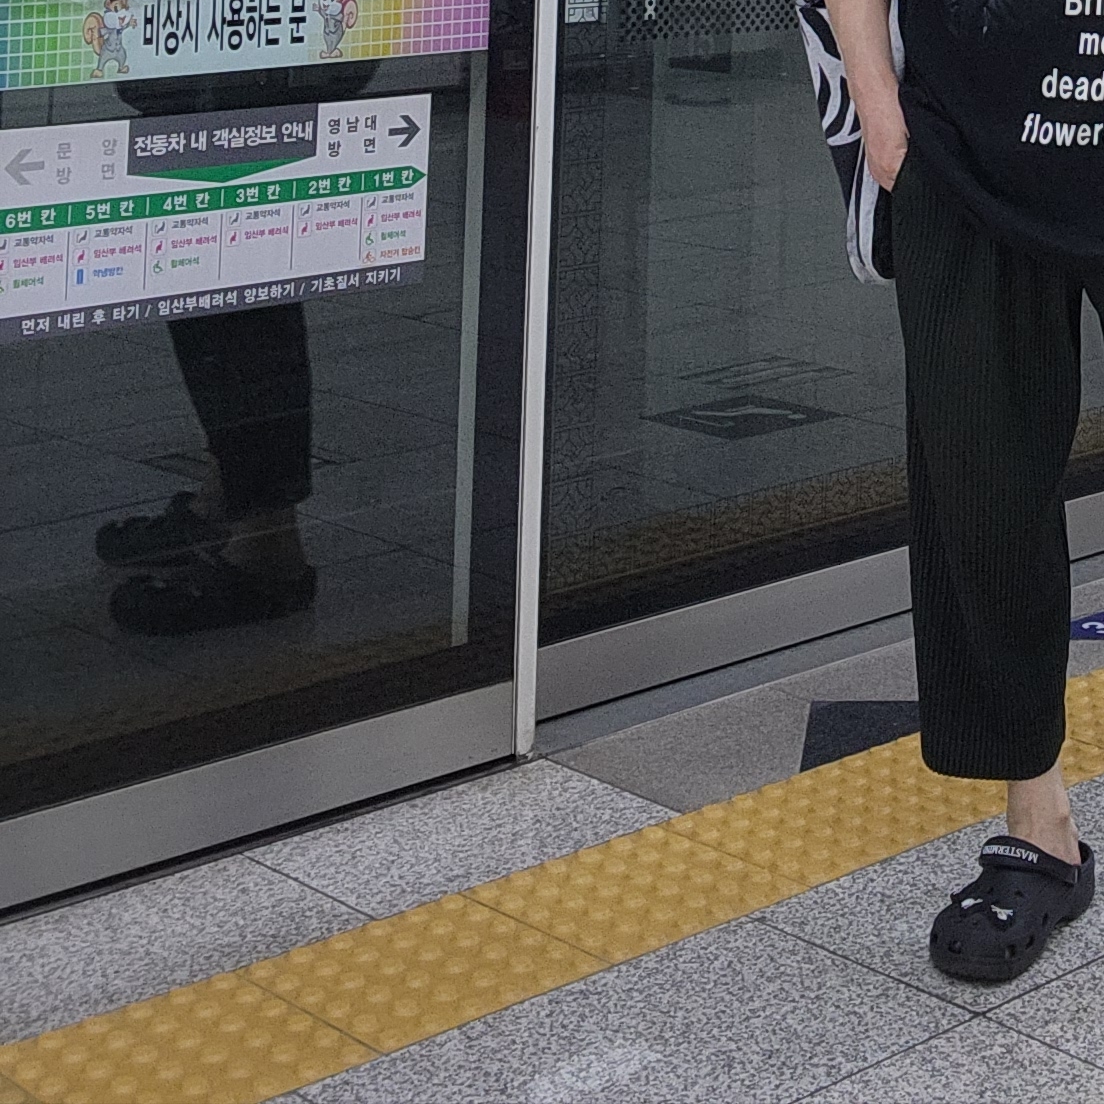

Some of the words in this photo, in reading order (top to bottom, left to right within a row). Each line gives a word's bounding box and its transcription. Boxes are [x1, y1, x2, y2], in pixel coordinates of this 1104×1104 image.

[328, 114, 377, 135] 영남대
[133, 131, 186, 157] 전동차
[190, 130, 207, 152] 내
[212, 123, 277, 149] 객실정보
[281, 120, 314, 143] 안내
[308, 178, 331, 195] 2번
[338, 176, 351, 193] 칸
[373, 173, 395, 188] 1번
[401, 169, 415, 185] 칸
[162, 194, 187, 211] 4번
[195, 192, 210, 209] 칸
[235, 187, 260, 203] 3번
[267, 184, 281, 200] 칸
[5, 211, 32, 229] 6번
[40, 209, 57, 226] 칸
[85, 201, 111, 220] 5번
[119, 200, 135, 217] 칸
[21, 316, 50, 335] 먼저
[57, 311, 85, 330] 내린
[91, 308, 106, 325] 후
[112, 303, 140, 322] 타기
[158, 290, 238, 317] 임산부배려석
[244, 282, 295, 304] 양보하기
[311, 272, 360, 293] 기초질서
[365, 266, 401, 285] 지키기
